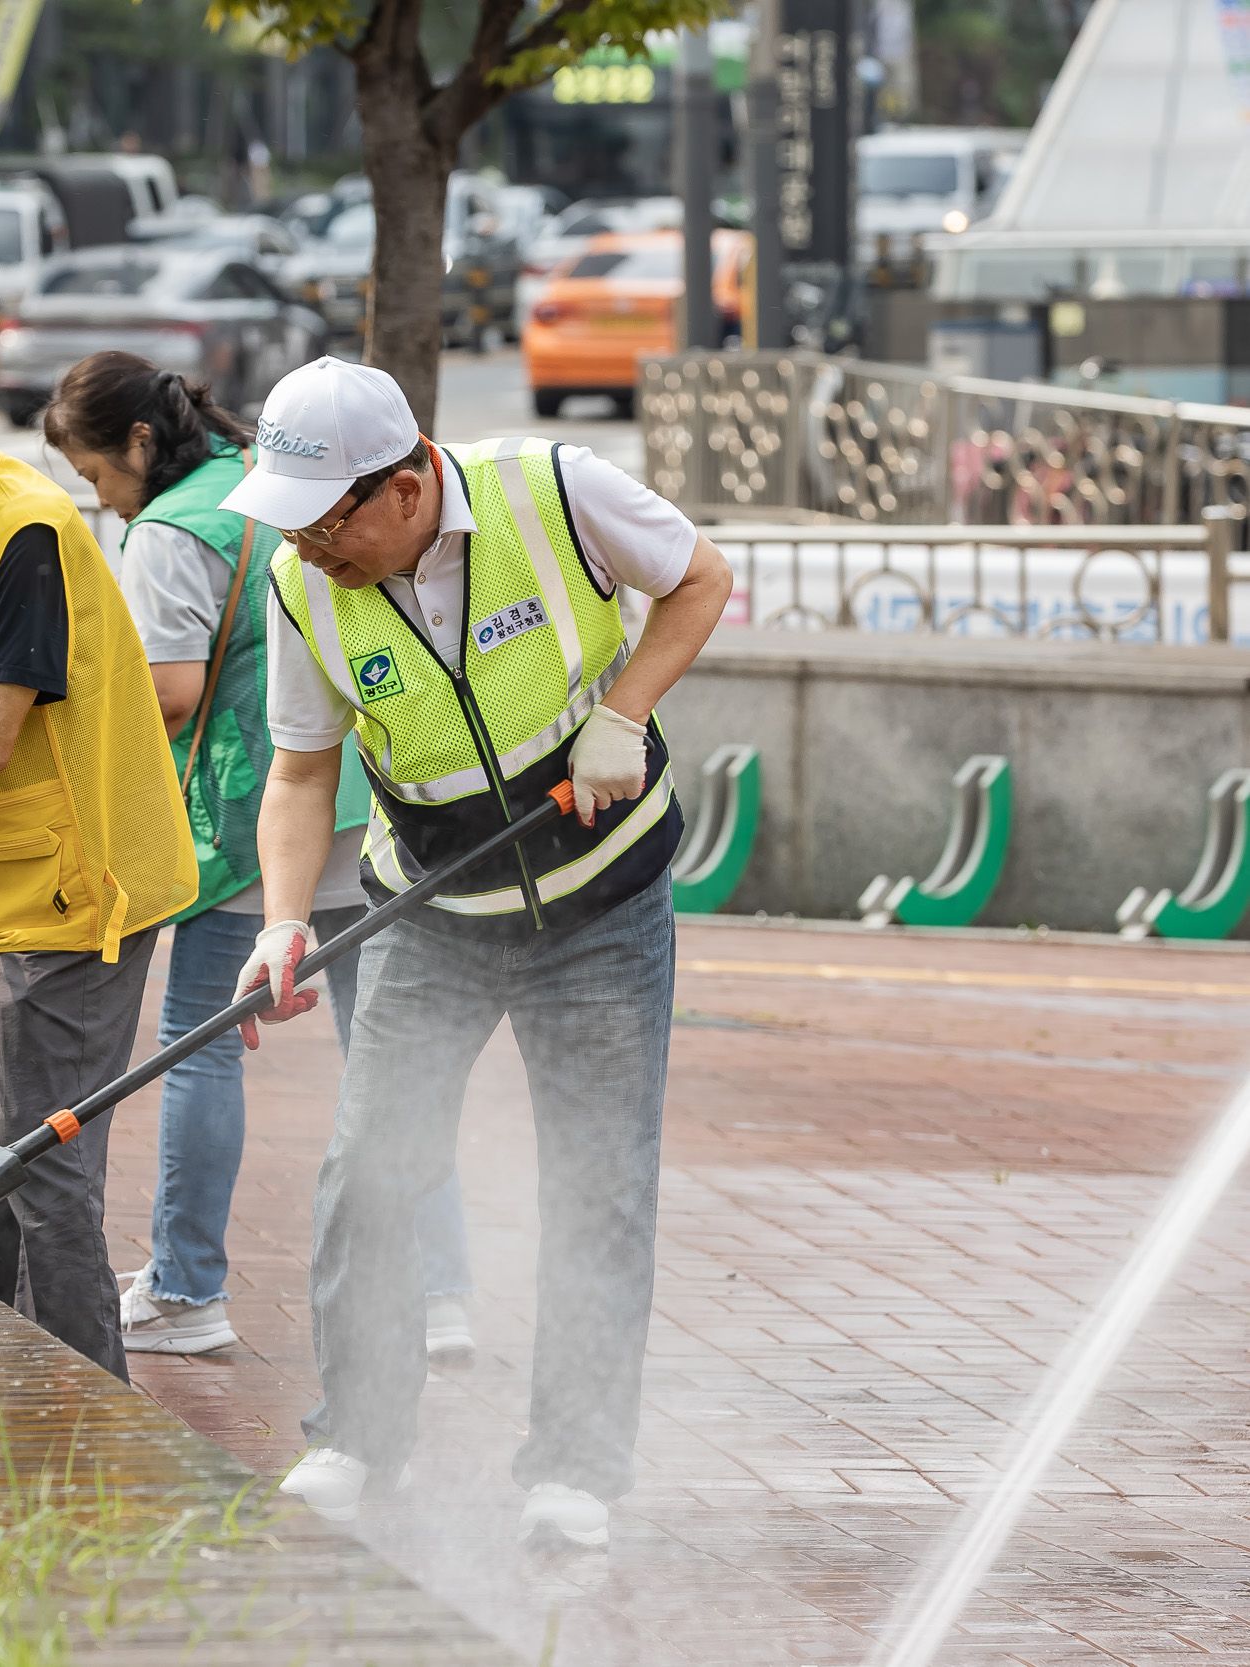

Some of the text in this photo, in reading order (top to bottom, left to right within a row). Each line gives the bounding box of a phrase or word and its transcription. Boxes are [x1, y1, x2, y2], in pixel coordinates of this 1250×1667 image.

[256, 415, 330, 460] Titleist
[351, 448, 387, 470] PRO
[497, 613, 544, 639] 광진구청장
[364, 680, 398, 698] 광진구
